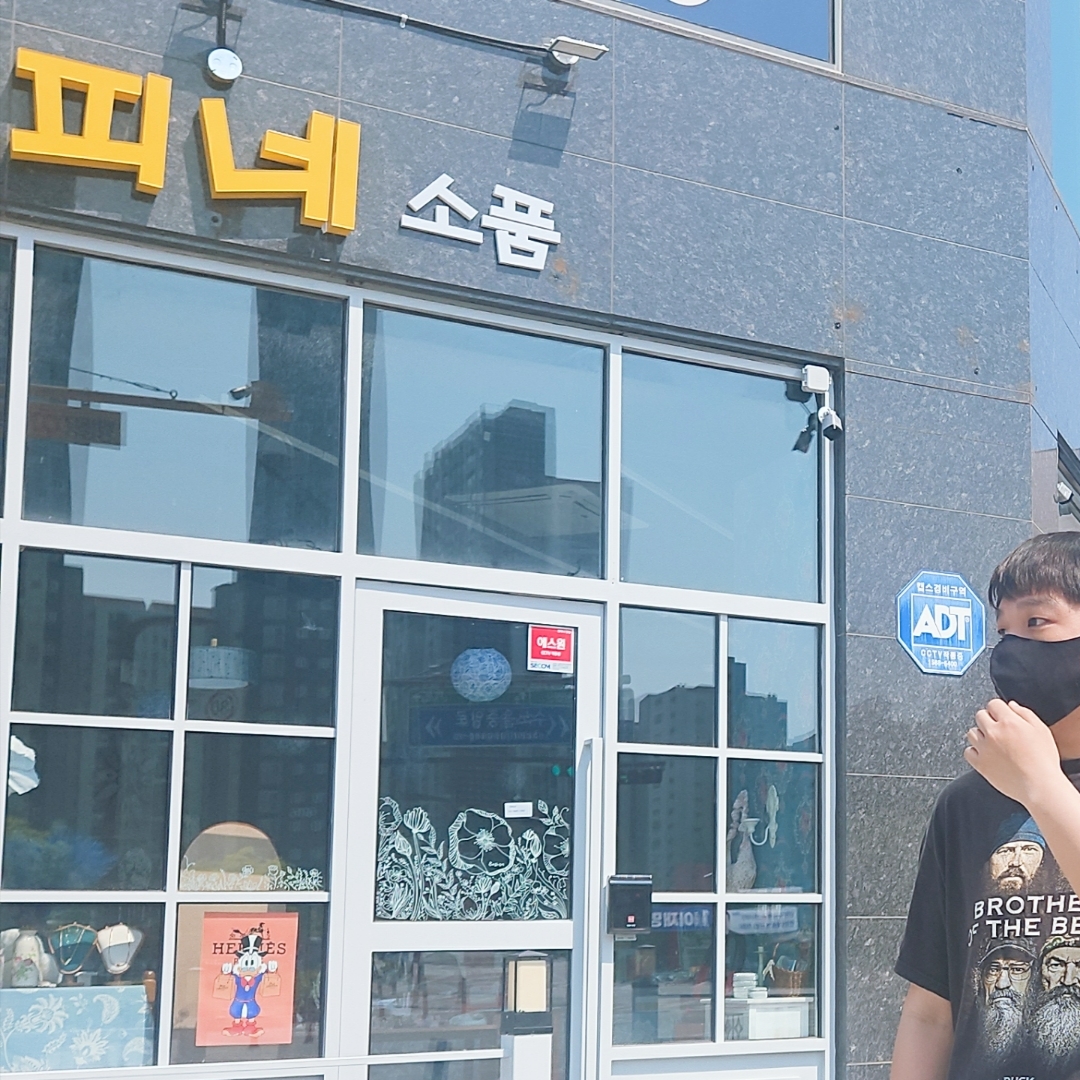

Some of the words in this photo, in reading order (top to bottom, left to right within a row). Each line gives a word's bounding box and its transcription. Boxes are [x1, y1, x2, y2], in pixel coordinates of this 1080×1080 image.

[10, 46, 362, 237] 피네
[400, 172, 562, 272] 소품
[916, 581, 967, 597] 캡스경비구역
[912, 603, 971, 641] ADT
[536, 634, 566, 651] 에스원
[985, 916, 1042, 939] THE
